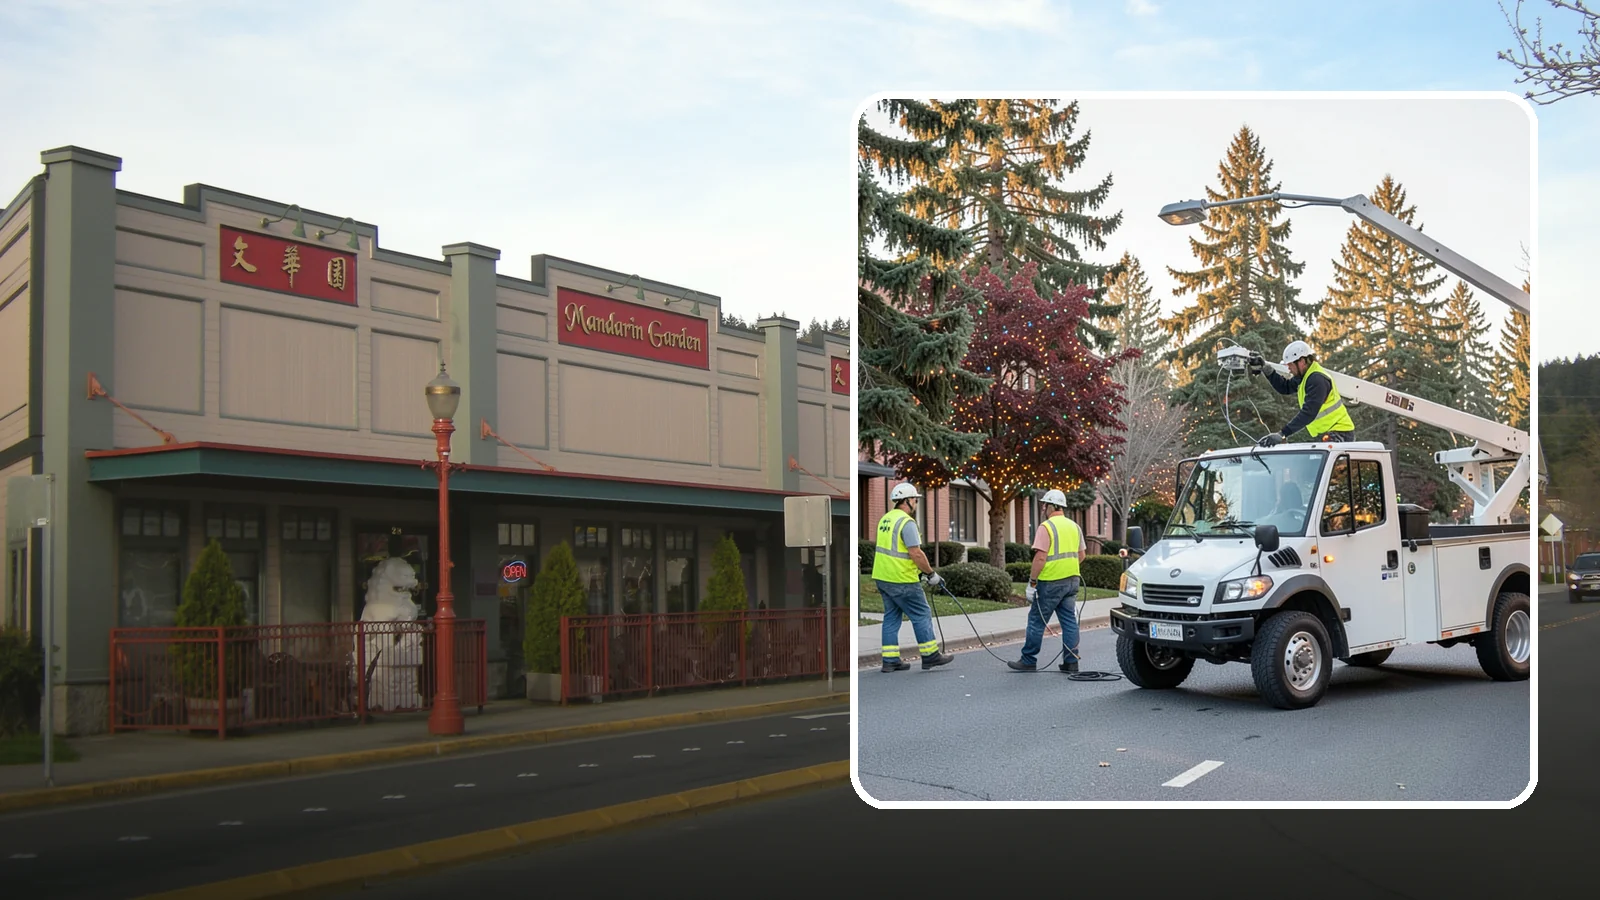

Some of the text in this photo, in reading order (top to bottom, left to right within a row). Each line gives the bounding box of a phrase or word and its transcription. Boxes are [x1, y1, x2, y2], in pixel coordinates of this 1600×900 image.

[564, 302, 701, 352] Mandarin Garden
[503, 565, 526, 578] OPEN
